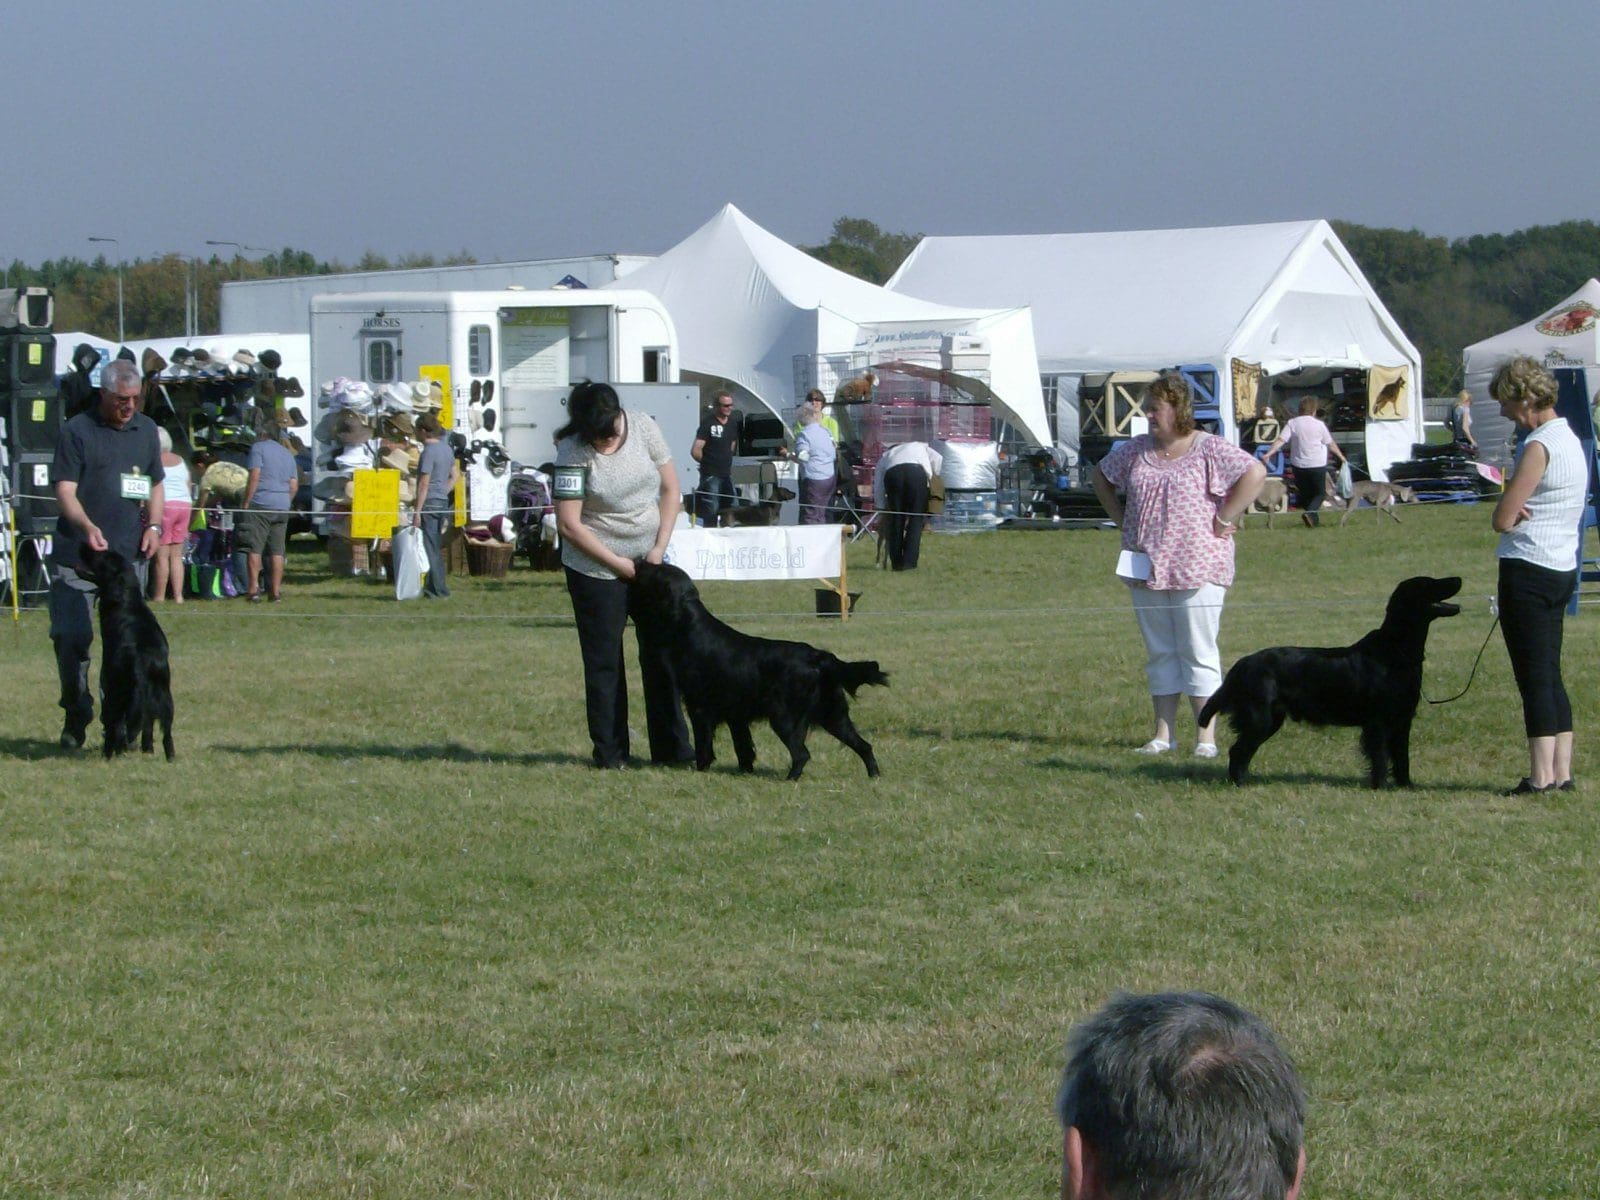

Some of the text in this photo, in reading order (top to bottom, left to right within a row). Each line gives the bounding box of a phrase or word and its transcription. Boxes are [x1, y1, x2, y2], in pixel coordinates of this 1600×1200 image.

[363, 317, 400, 327] HORSES
[558, 478, 577, 489] 2301
[696, 547, 805, 569] Driffield
